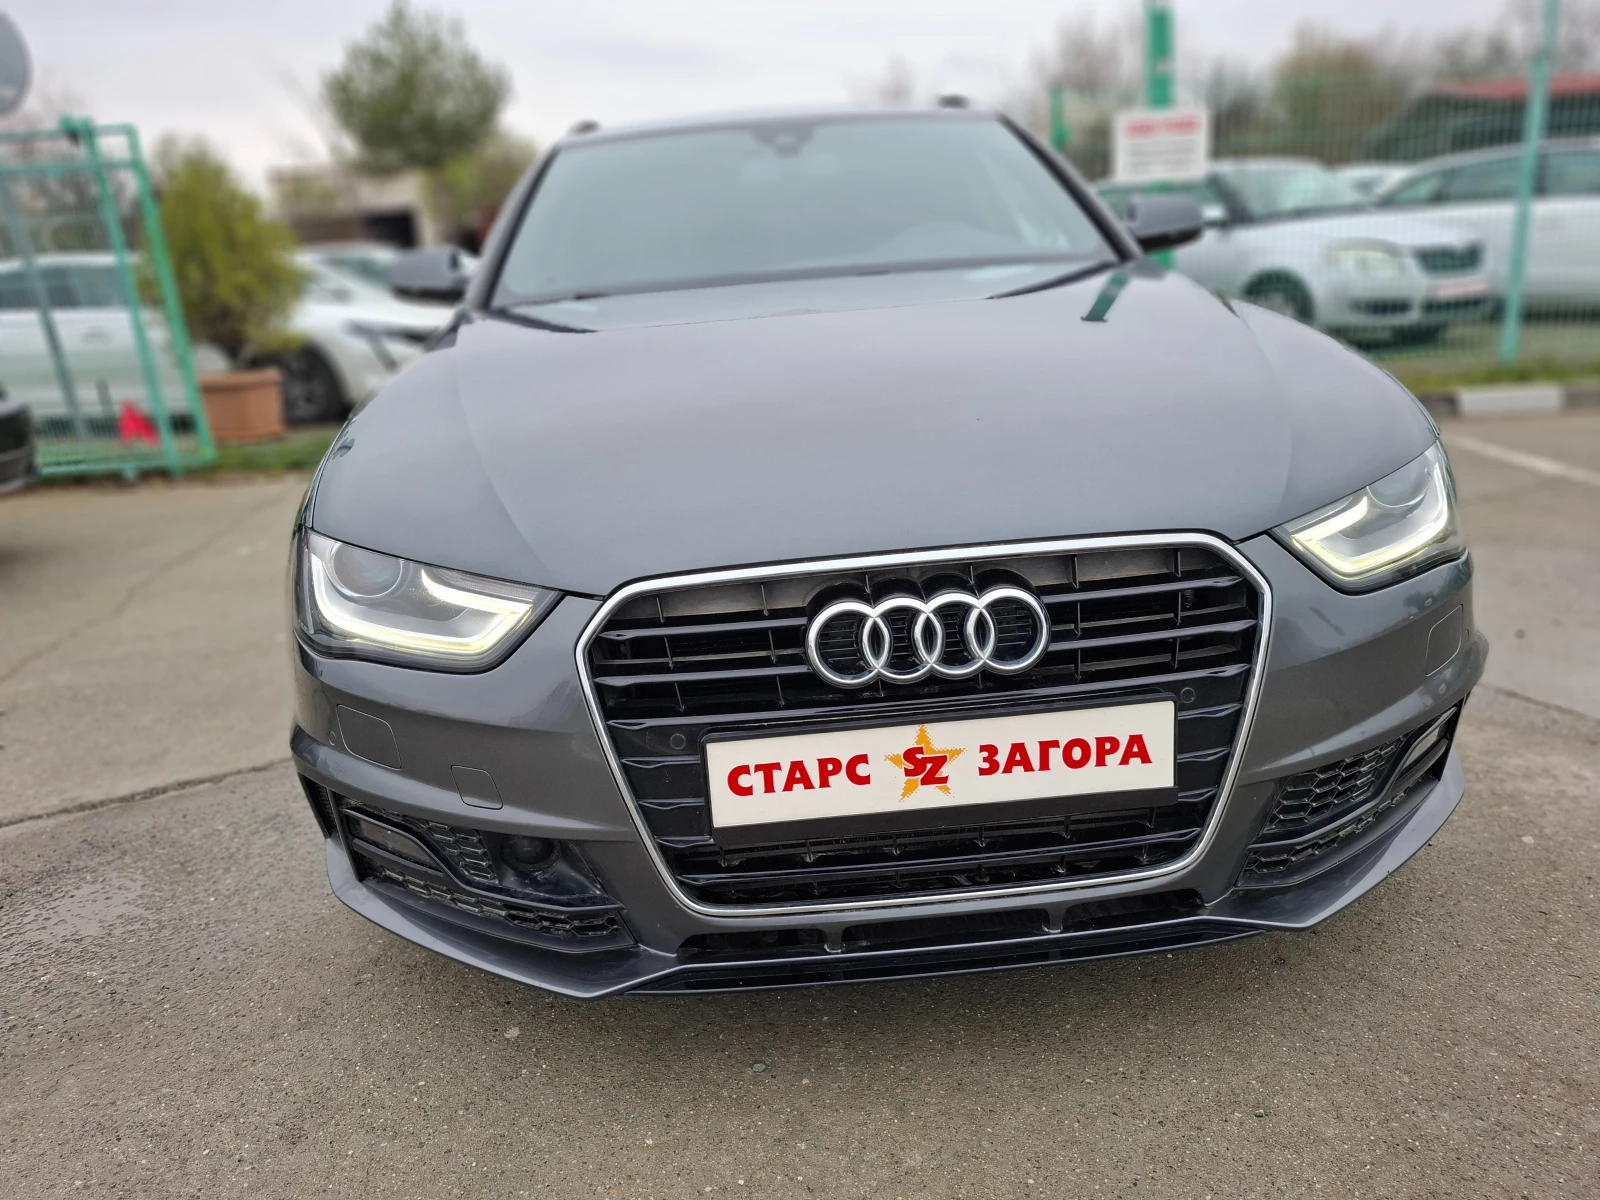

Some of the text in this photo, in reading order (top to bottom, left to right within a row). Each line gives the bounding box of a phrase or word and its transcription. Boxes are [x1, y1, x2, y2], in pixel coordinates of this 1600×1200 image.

[727, 734, 1153, 797] СТАРС SZ ЗАГОРА
